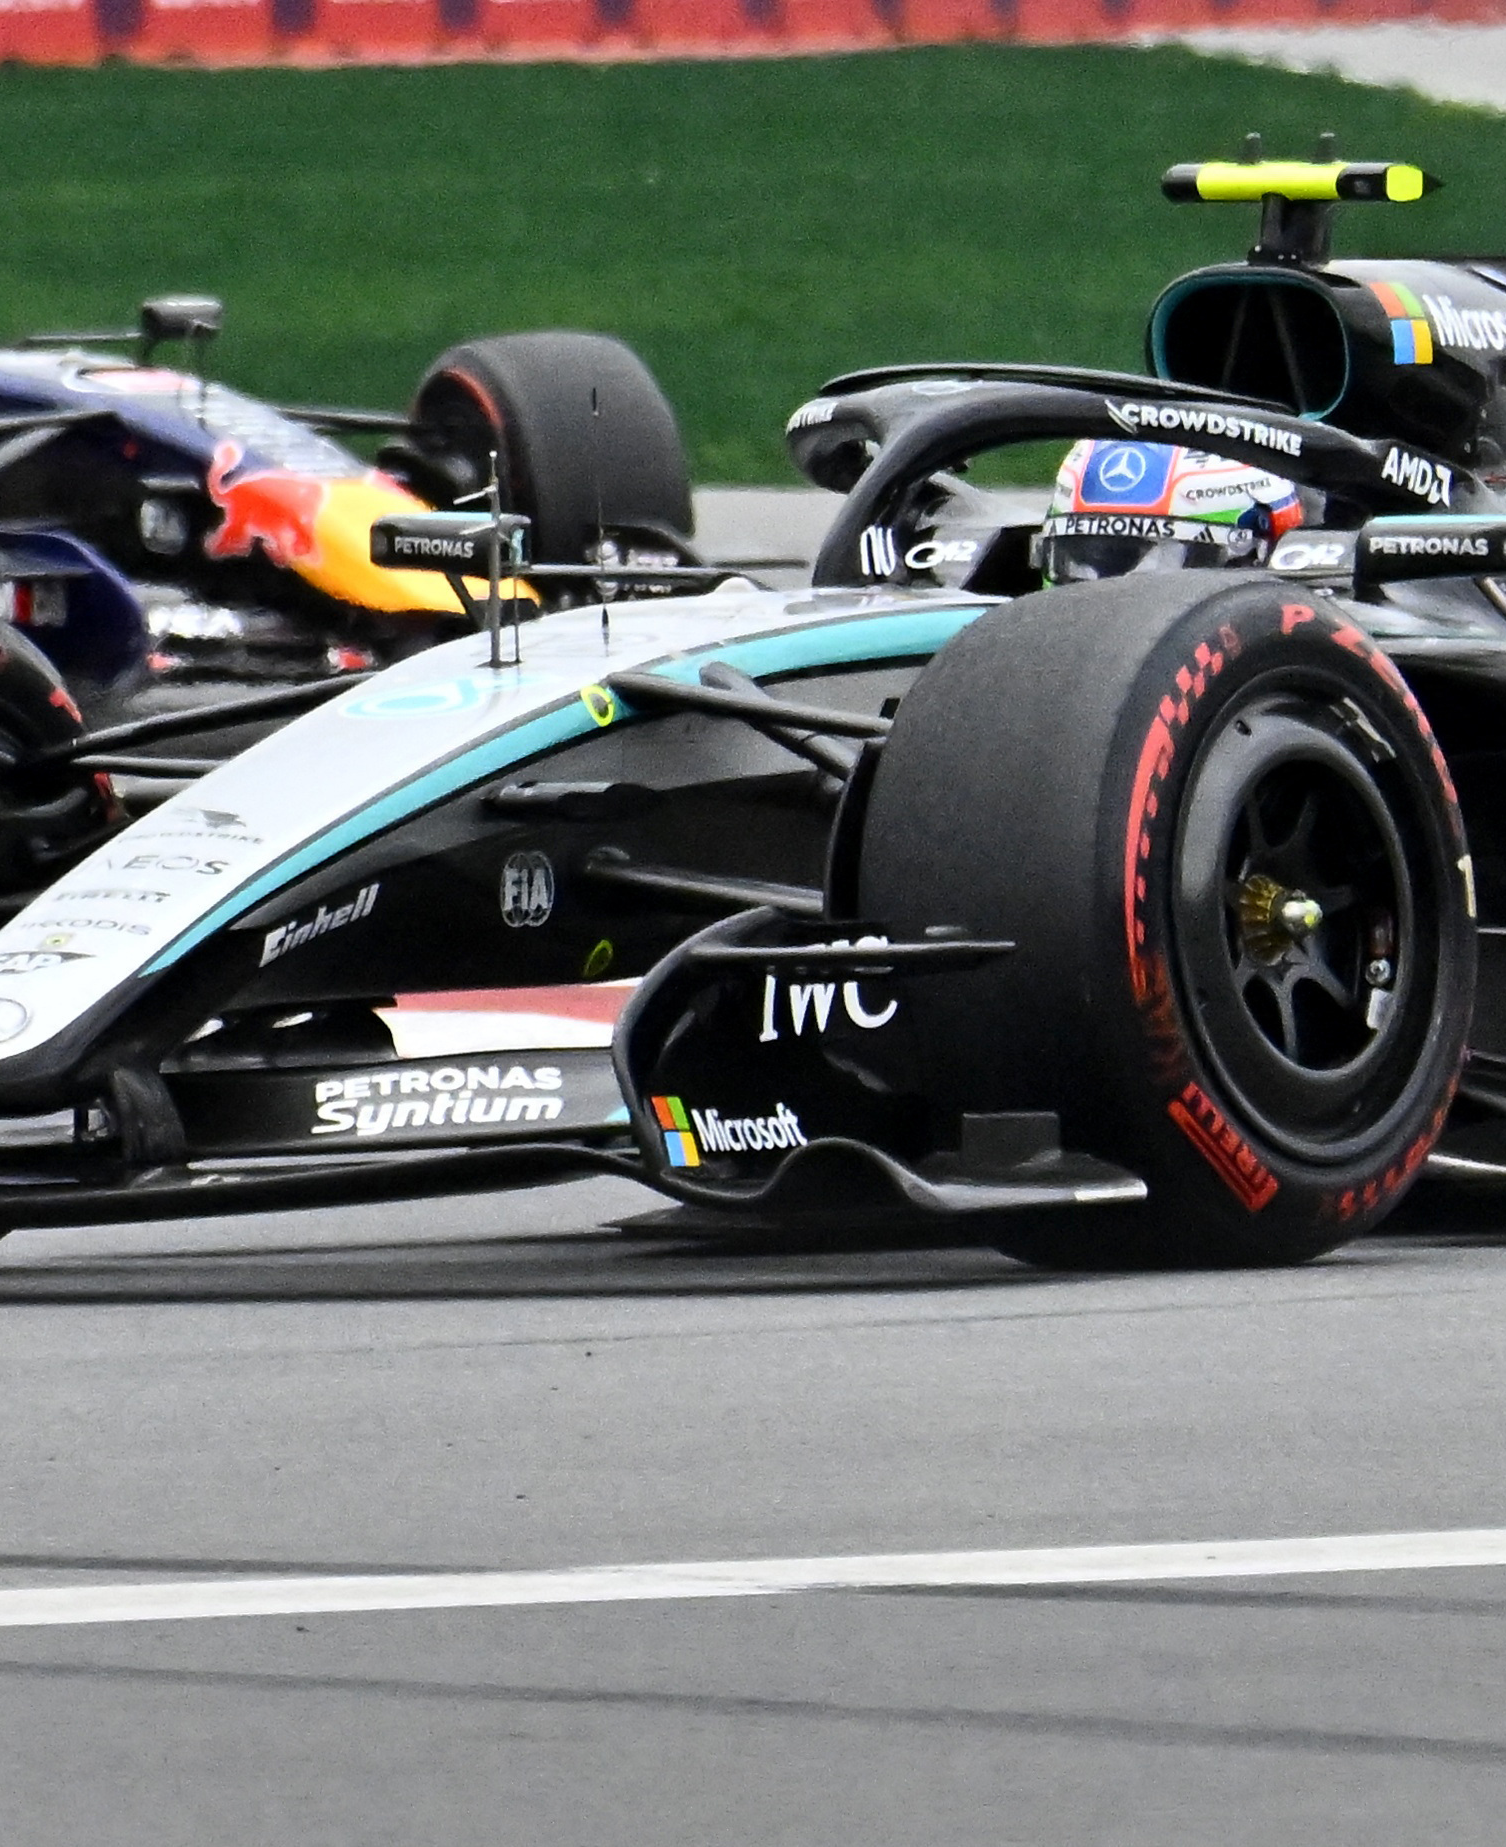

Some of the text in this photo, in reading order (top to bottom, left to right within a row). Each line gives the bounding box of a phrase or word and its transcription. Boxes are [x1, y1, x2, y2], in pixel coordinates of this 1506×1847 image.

[1120, 401, 1304, 458] CROWDSTRIKE
[1184, 477, 1272, 508] CROWDSTRIKE
[1381, 446, 1437, 504] AMD
[394, 535, 475, 560] PETRONAS
[1065, 515, 1176, 539] PETRONAS
[1368, 534, 1490, 558] PETRONAS
[504, 867, 550, 911] FIA
[259, 882, 382, 968] Einhell
[313, 1065, 563, 1104] PETRONAS
[310, 1095, 564, 1138] Syntium
[692, 1101, 808, 1153] Microsoft
